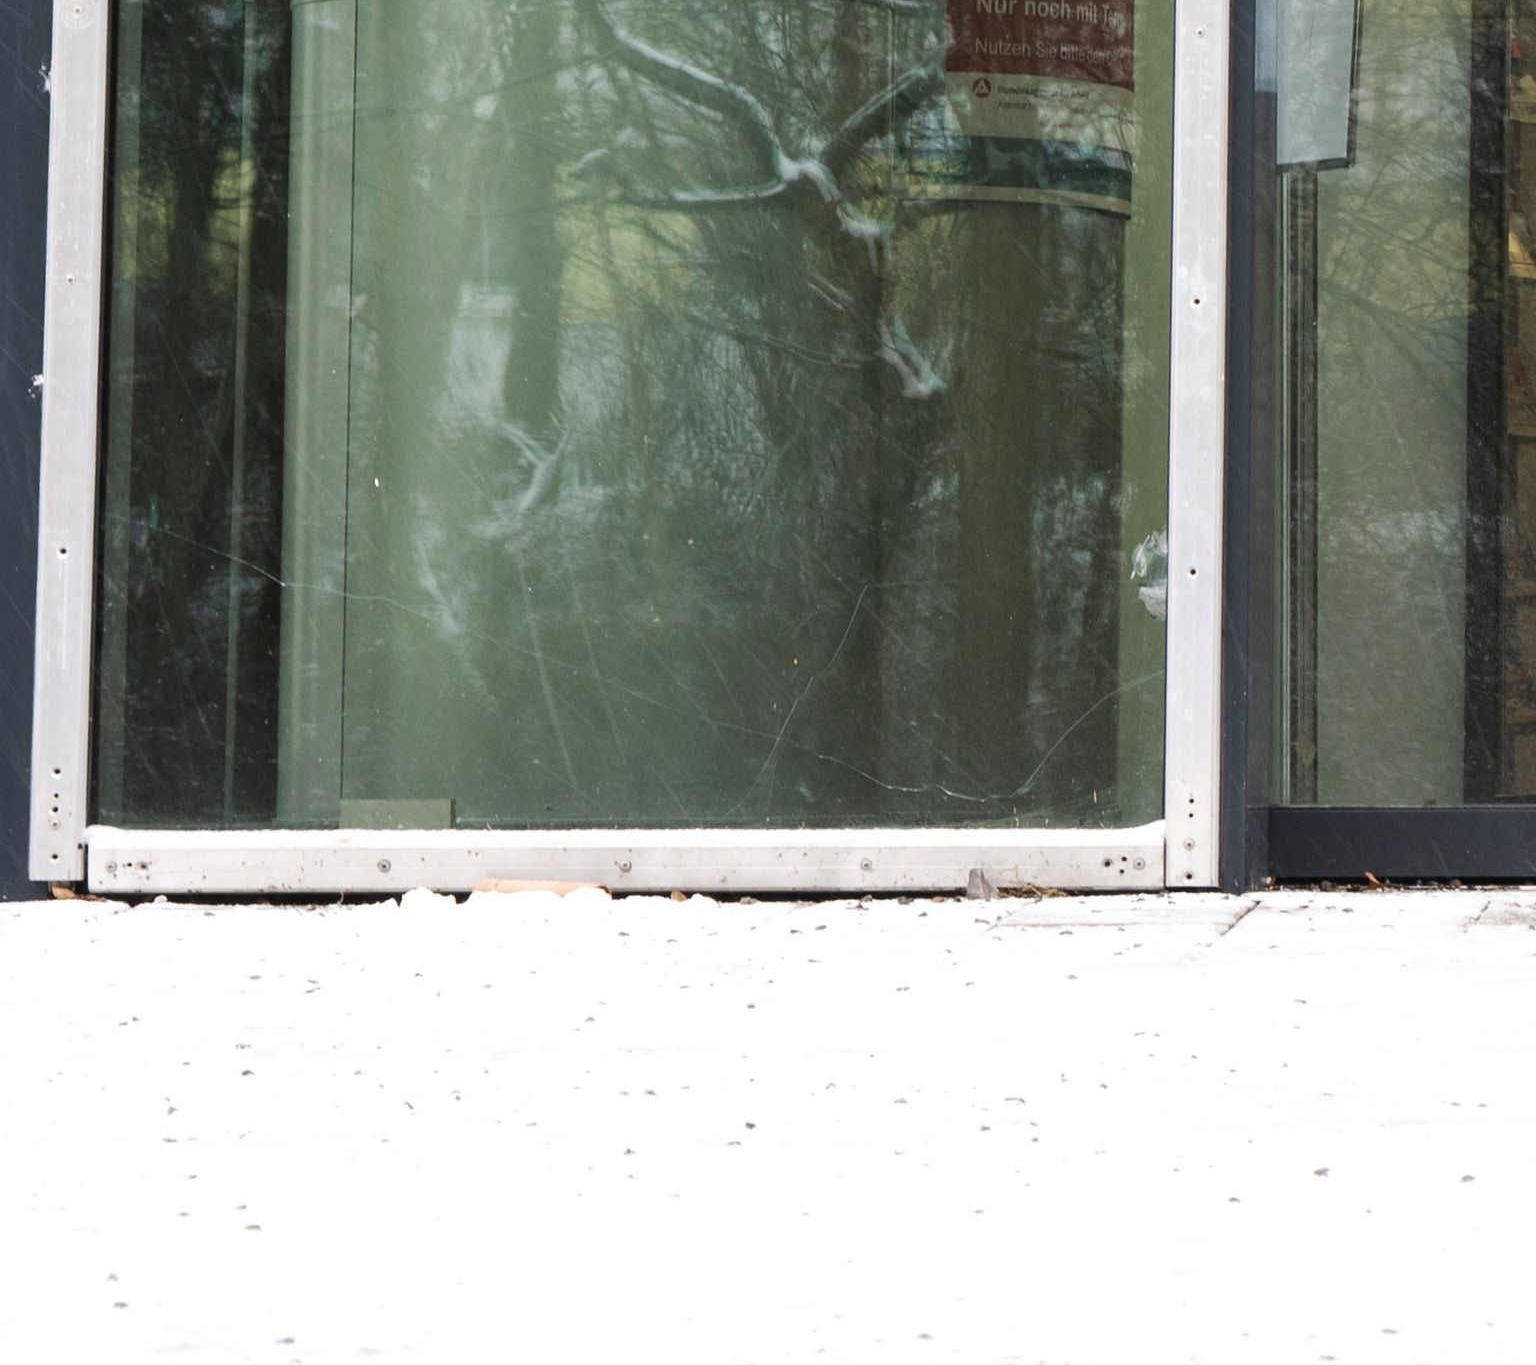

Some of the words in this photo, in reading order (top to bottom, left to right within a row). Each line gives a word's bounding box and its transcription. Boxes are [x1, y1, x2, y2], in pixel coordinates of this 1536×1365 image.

[1075, 1, 1099, 24] mit
[974, 37, 1031, 57] Nutzen
[1035, 41, 1056, 60] Sie
[1059, 42, 1084, 62] bitte
